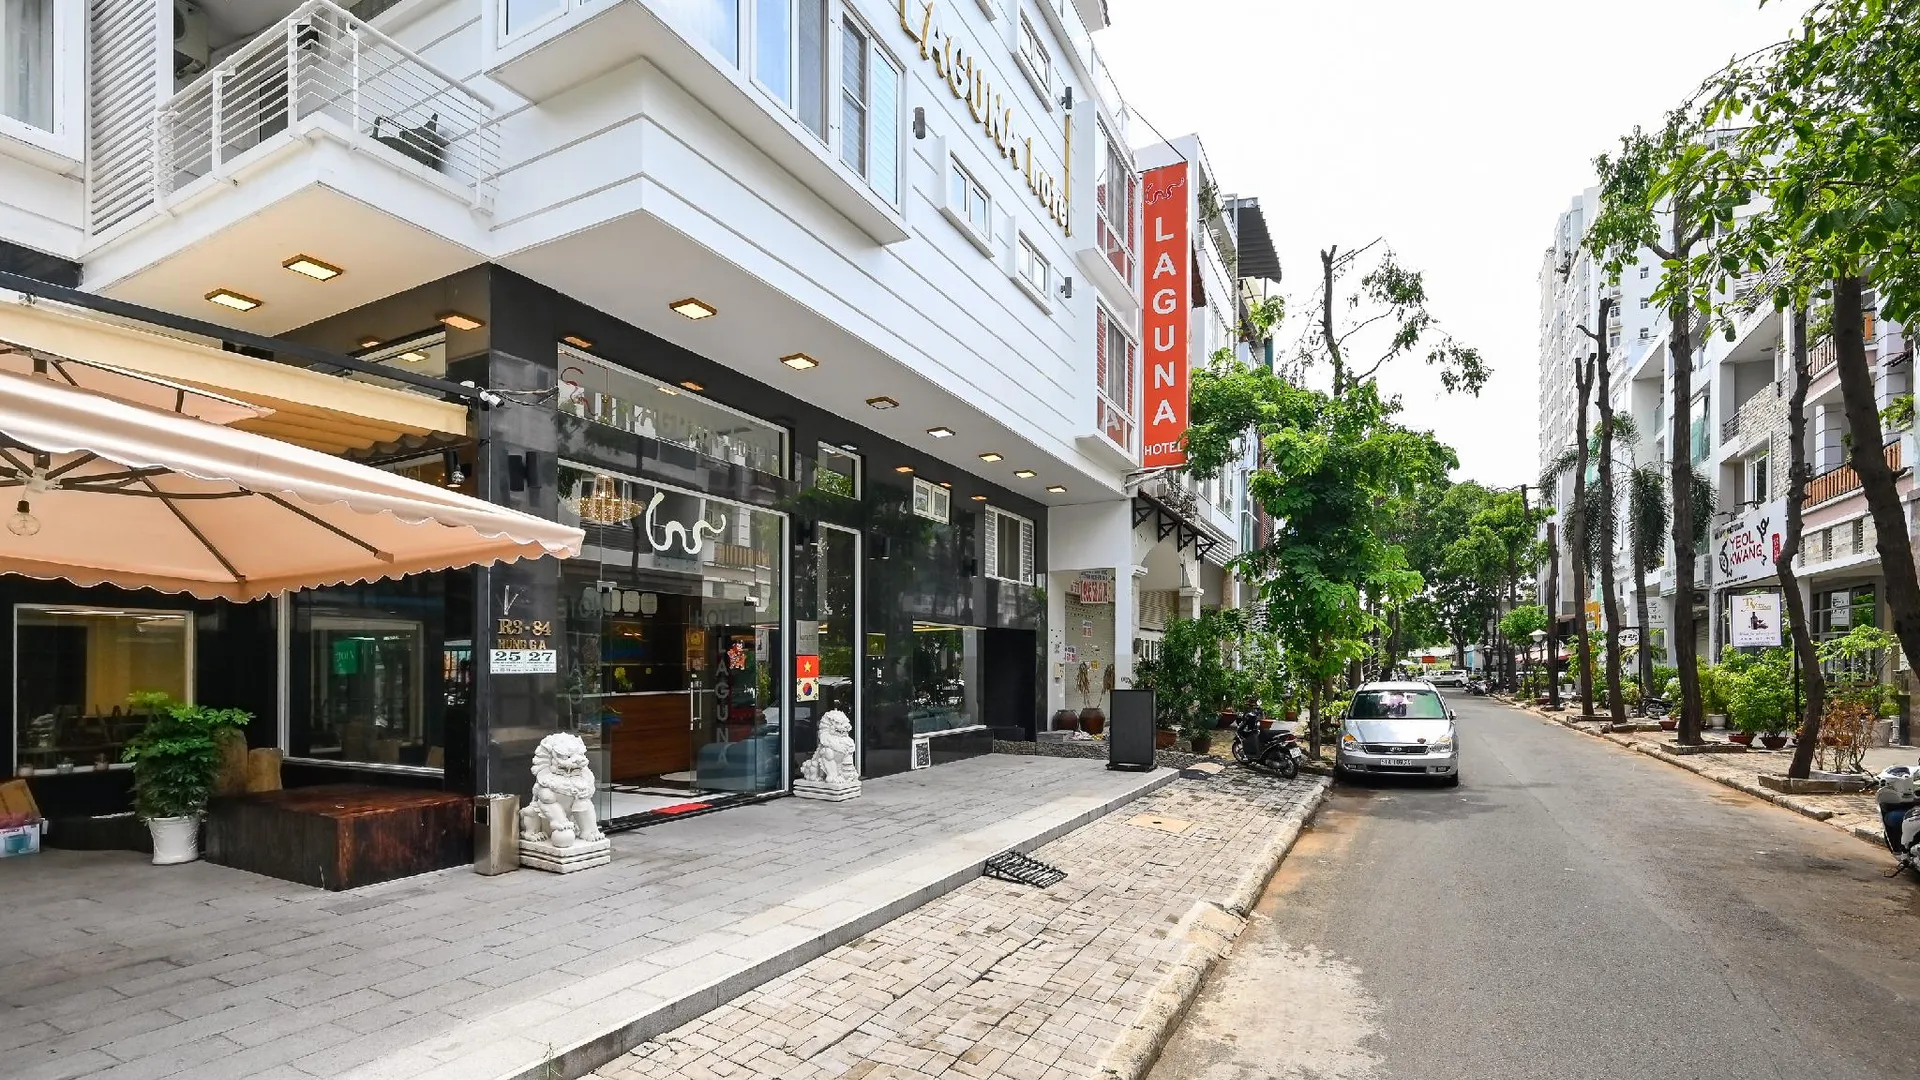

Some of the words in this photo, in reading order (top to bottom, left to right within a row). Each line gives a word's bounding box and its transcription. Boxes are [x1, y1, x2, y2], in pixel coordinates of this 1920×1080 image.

[897, 0, 1019, 170] LAGUNA
[1152, 216, 1178, 427] LAGUNA
[1144, 440, 1183, 457] HOTEL
[1729, 530, 1755, 551] YEOL
[1729, 544, 1763, 566] KWANG
[494, 651, 521, 662] 25
[528, 651, 553, 662] 27
[715, 636, 730, 767] LAGUNA
